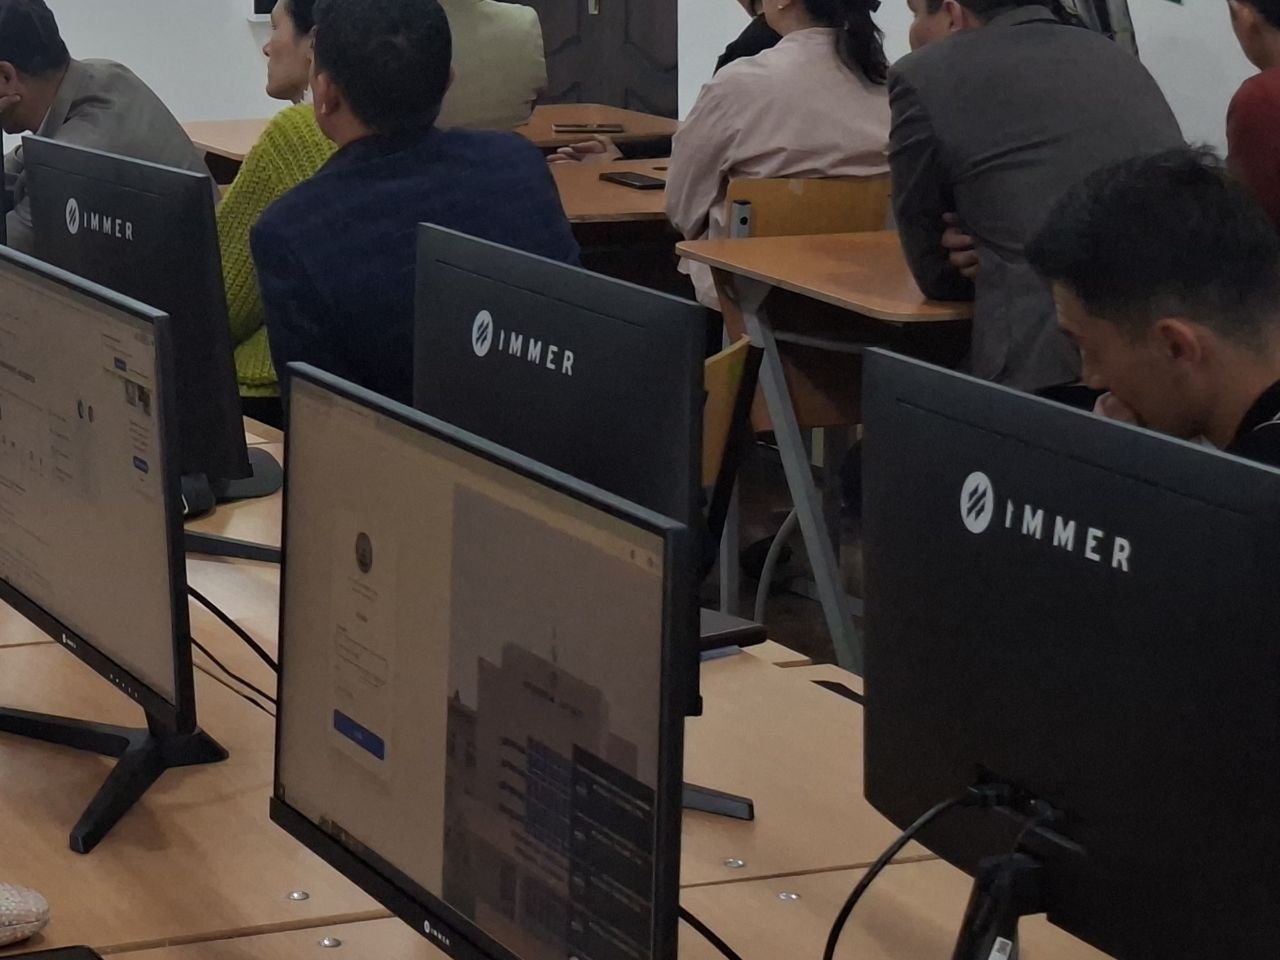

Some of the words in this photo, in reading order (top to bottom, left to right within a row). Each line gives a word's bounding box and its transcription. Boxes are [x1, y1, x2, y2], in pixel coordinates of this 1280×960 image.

[83, 211, 134, 242] IMMER
[498, 328, 575, 377] IMMER
[1004, 497, 1132, 573] IMMER
